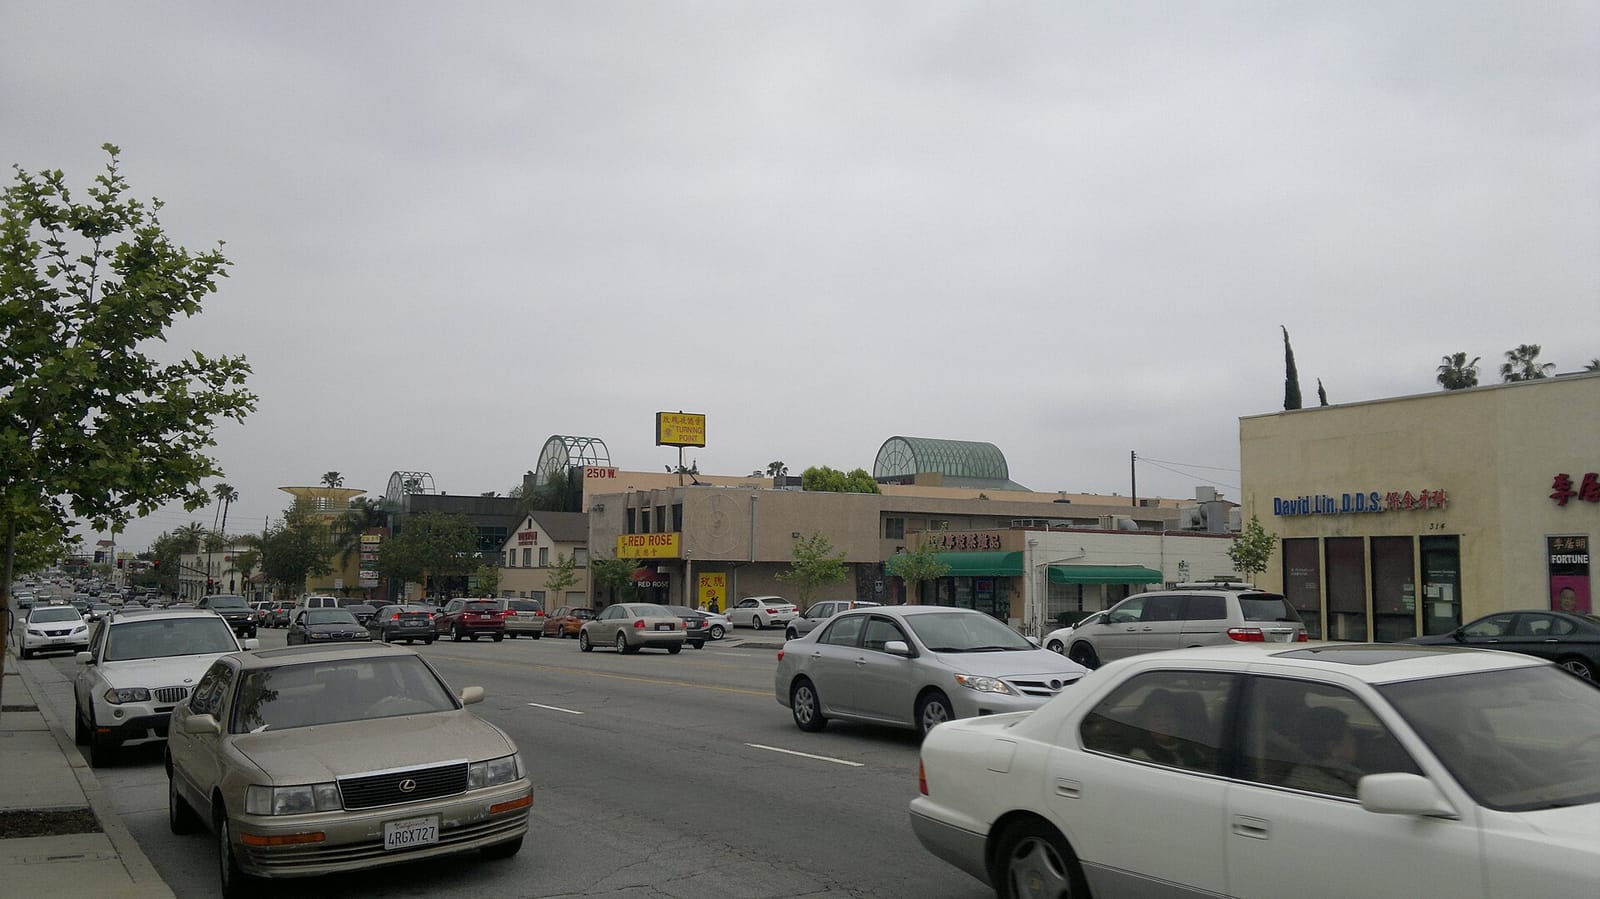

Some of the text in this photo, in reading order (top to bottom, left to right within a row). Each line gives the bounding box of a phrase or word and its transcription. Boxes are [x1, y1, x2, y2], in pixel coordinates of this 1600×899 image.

[676, 425, 703, 434] TURNING
[587, 468, 617, 479] 250 W.
[1273, 496, 1310, 516] David
[1342, 491, 1383, 513] D.D.S.
[628, 534, 673, 547] RED ROSE
[1551, 554, 1589, 564] FORTUNE
[637, 580, 669, 588] RED ROSE
[700, 575, 724, 587] 玫瑰
[388, 826, 435, 846] 4RGX727
